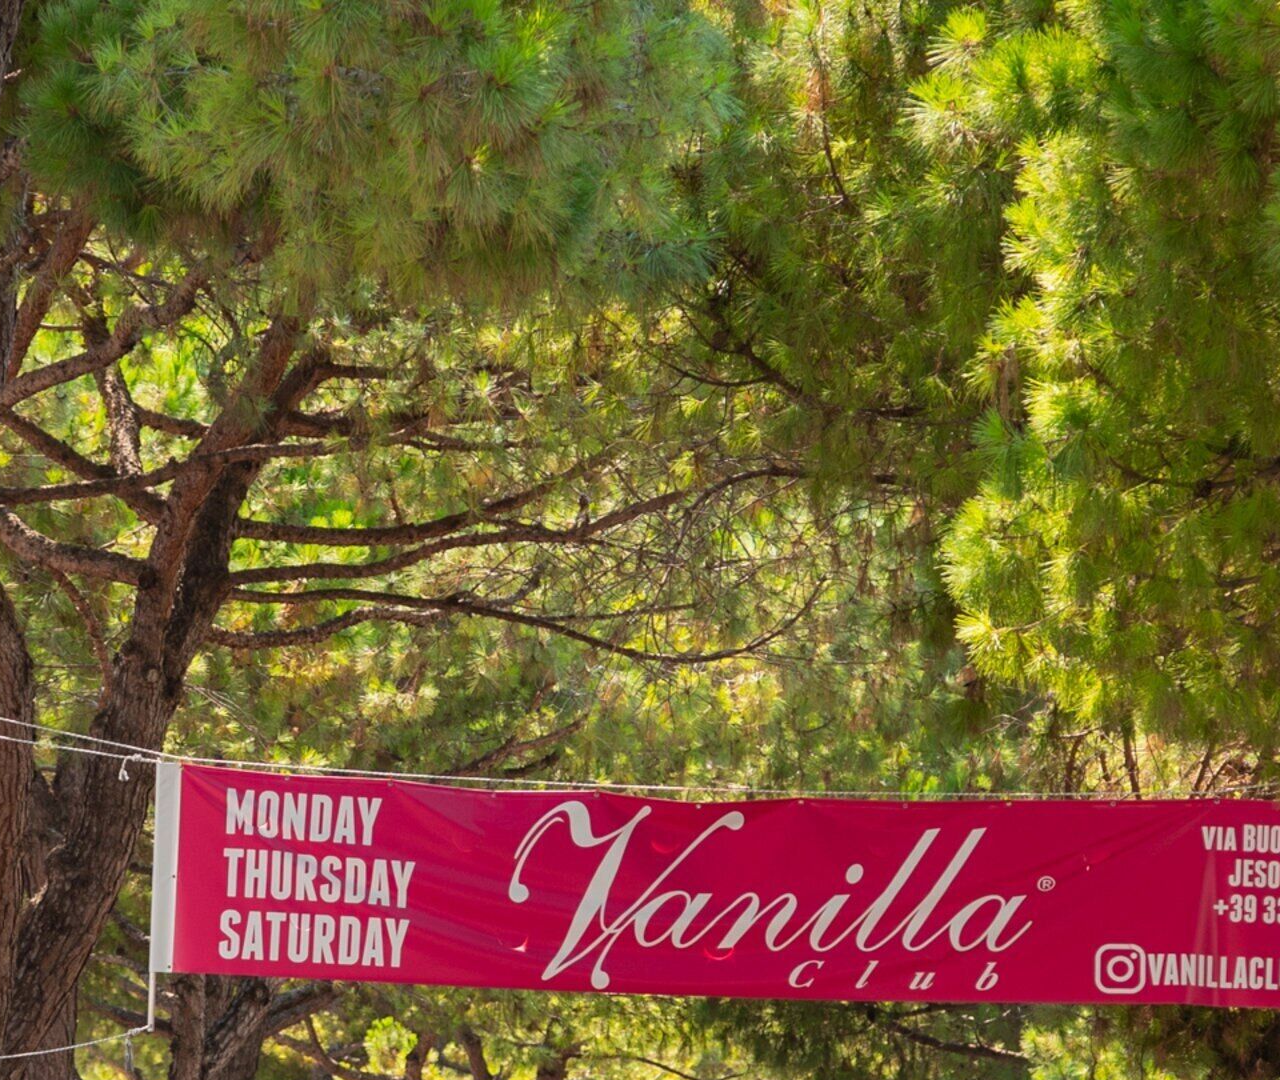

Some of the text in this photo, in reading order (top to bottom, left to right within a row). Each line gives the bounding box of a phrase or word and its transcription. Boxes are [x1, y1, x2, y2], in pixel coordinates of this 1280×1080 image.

[225, 787, 382, 846] MONDAY
[1201, 826, 1237, 851] VIA
[223, 847, 416, 908] THURSDAY
[509, 800, 1033, 989] Vanilla
[1213, 894, 1257, 923] +39
[218, 909, 410, 968] SATURDAY
[788, 959, 999, 991] Club
